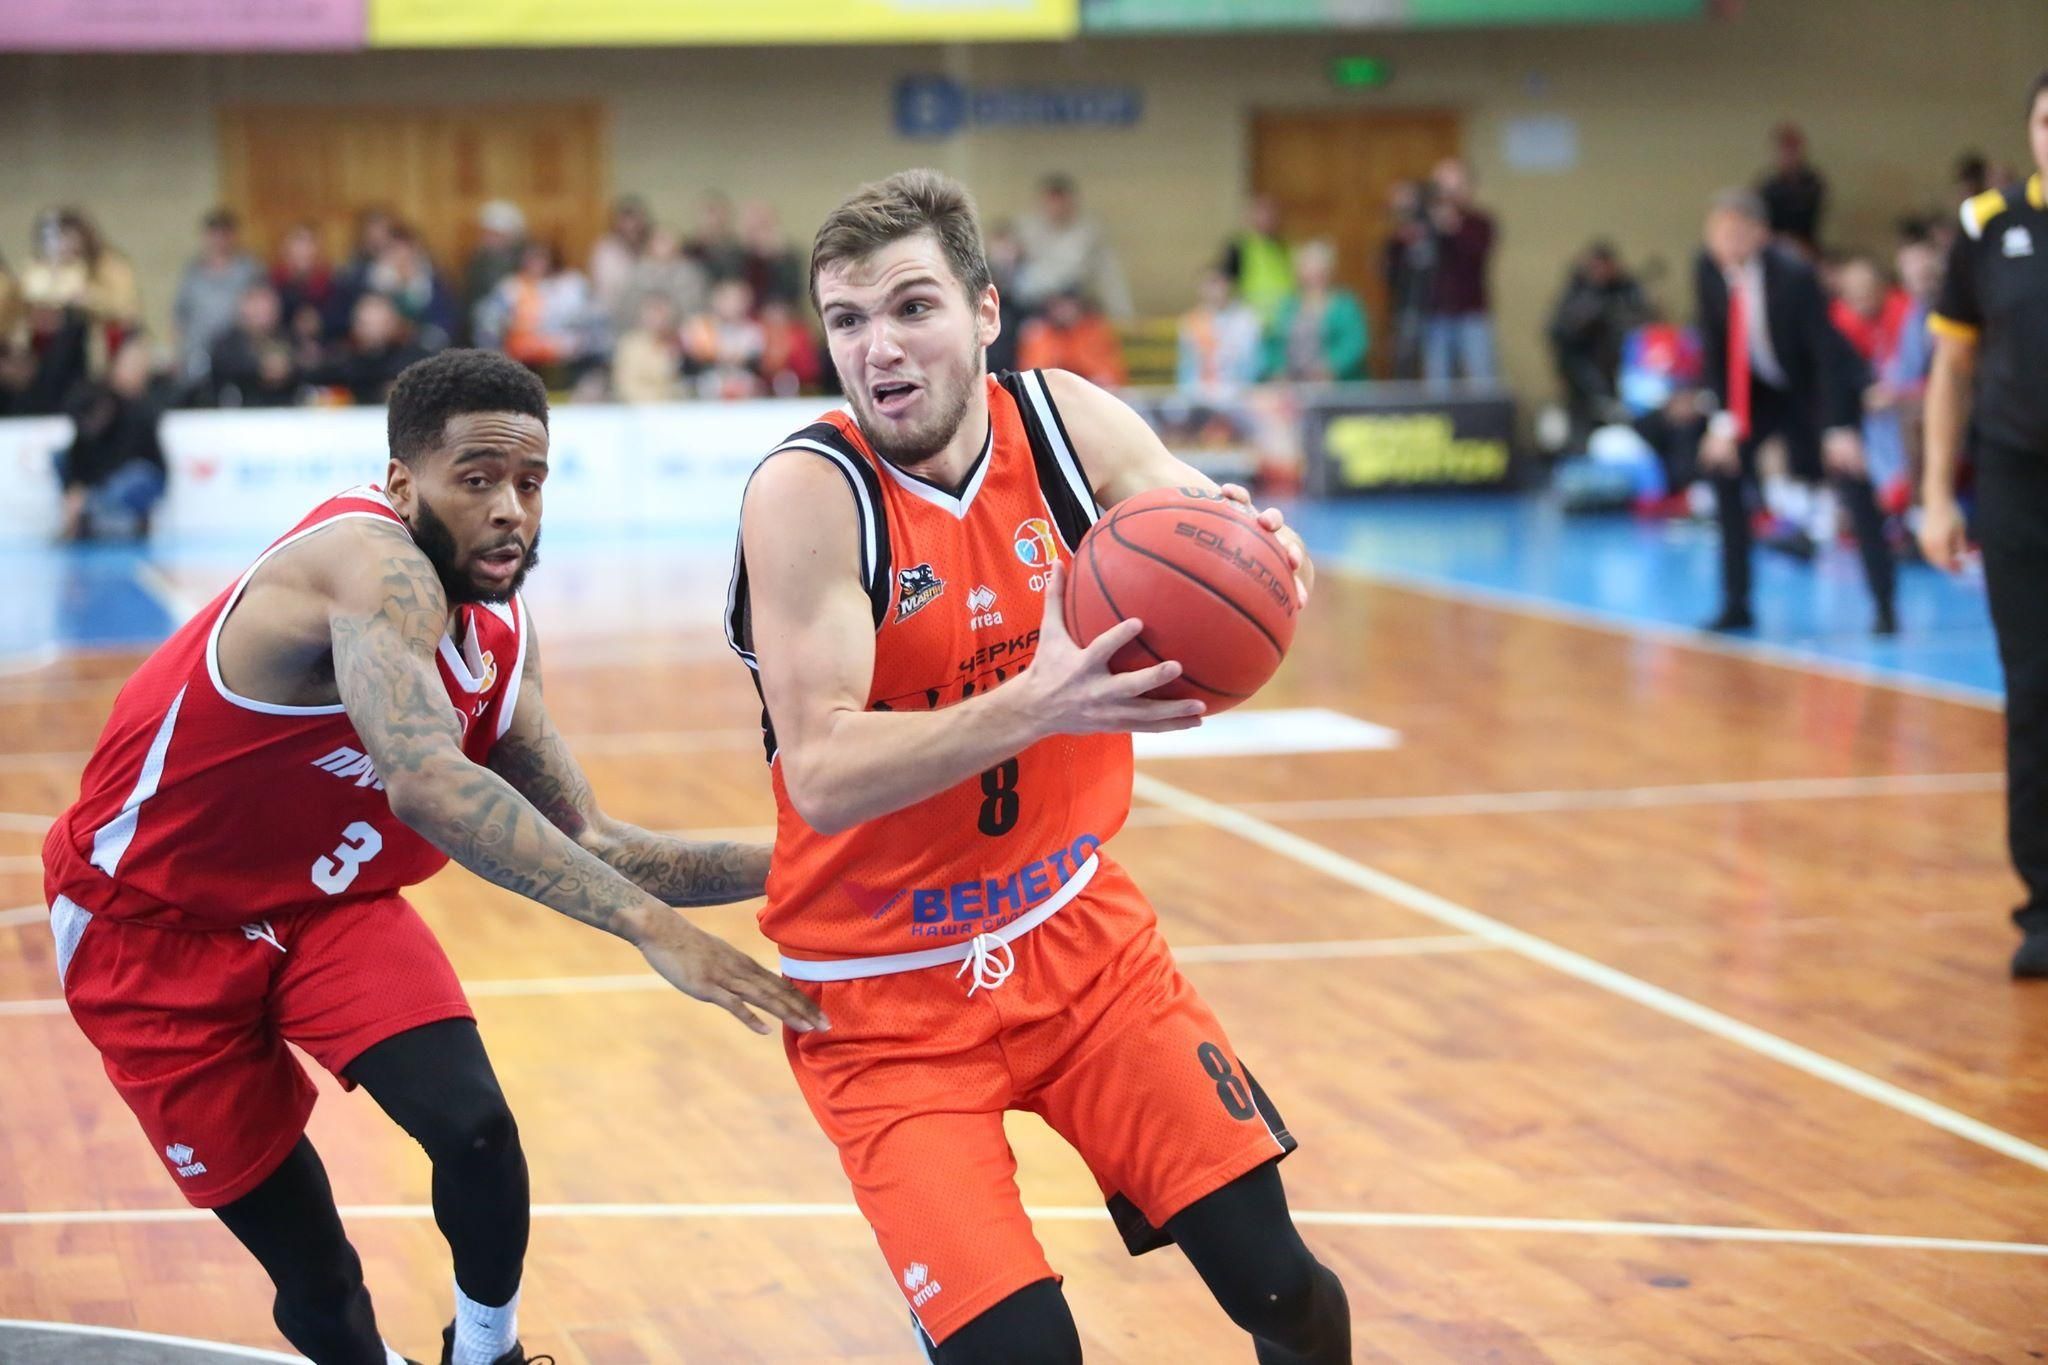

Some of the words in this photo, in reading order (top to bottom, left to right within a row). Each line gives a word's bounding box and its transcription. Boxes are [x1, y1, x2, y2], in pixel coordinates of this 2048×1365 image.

[1174, 522, 1294, 617] SOLUTION
[978, 756, 1019, 836] 8
[311, 821, 383, 895] 3
[911, 921, 973, 937] НАША
[982, 907, 1032, 931] СИЛ
[1197, 1042, 1256, 1121] 8
[177, 1161, 207, 1177] errea
[913, 1279, 942, 1308] errea
